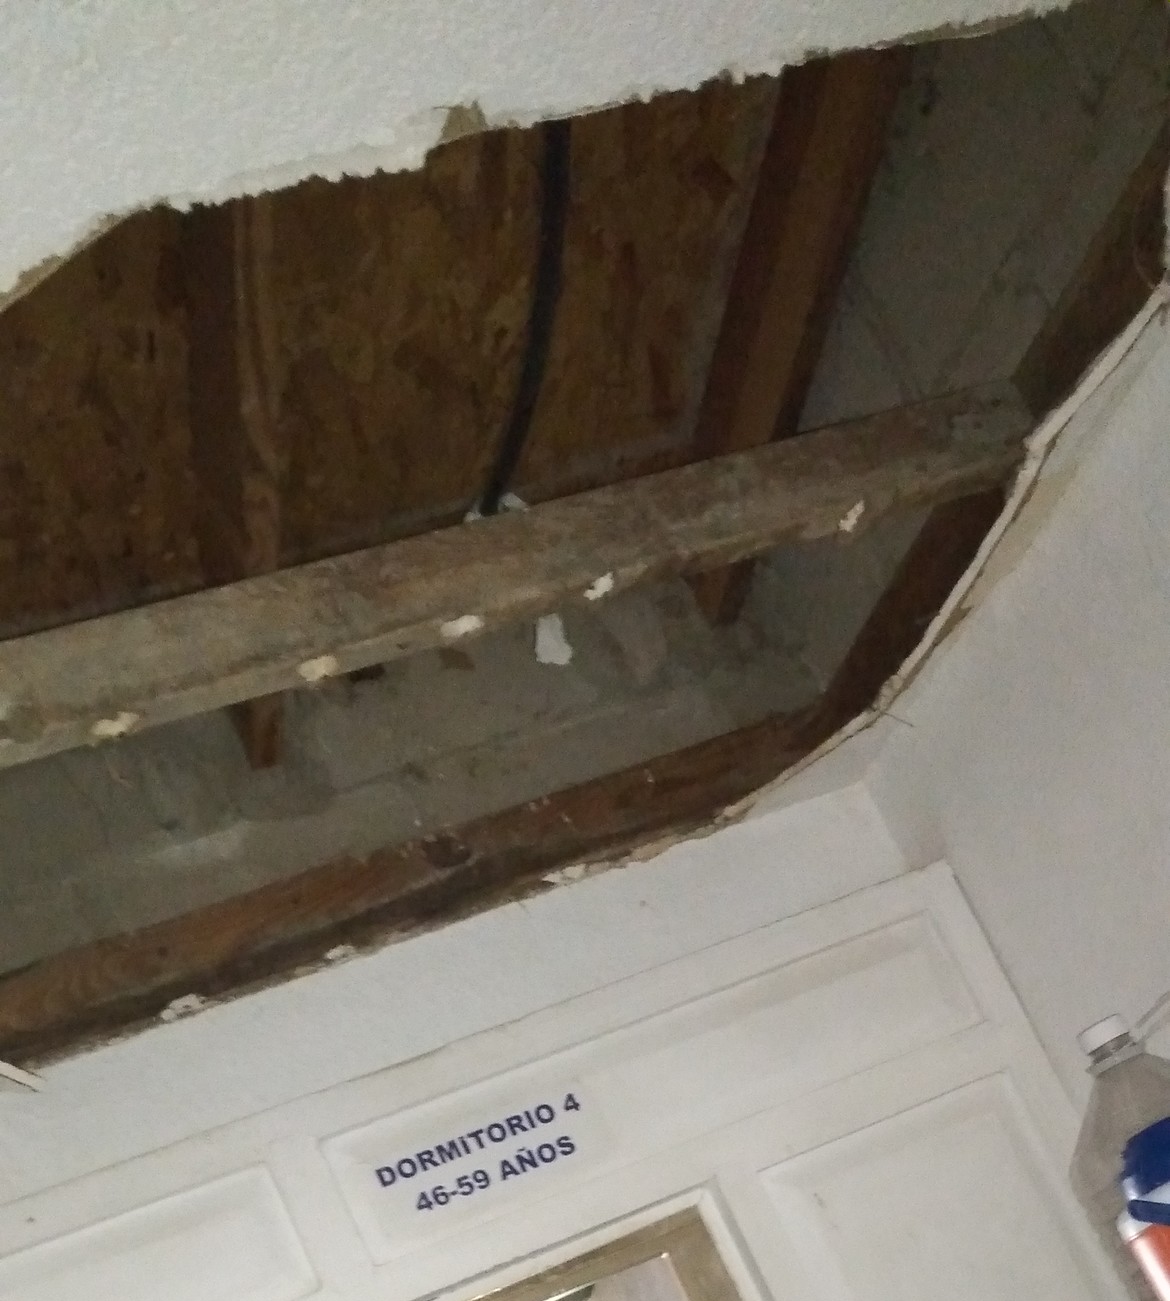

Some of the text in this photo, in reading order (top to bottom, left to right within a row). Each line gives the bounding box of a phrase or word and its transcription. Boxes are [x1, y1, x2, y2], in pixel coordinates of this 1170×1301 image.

[375, 1093, 580, 1187] DORMITORIO 4
[415, 1135, 576, 1211] 46-59 AÑOS
